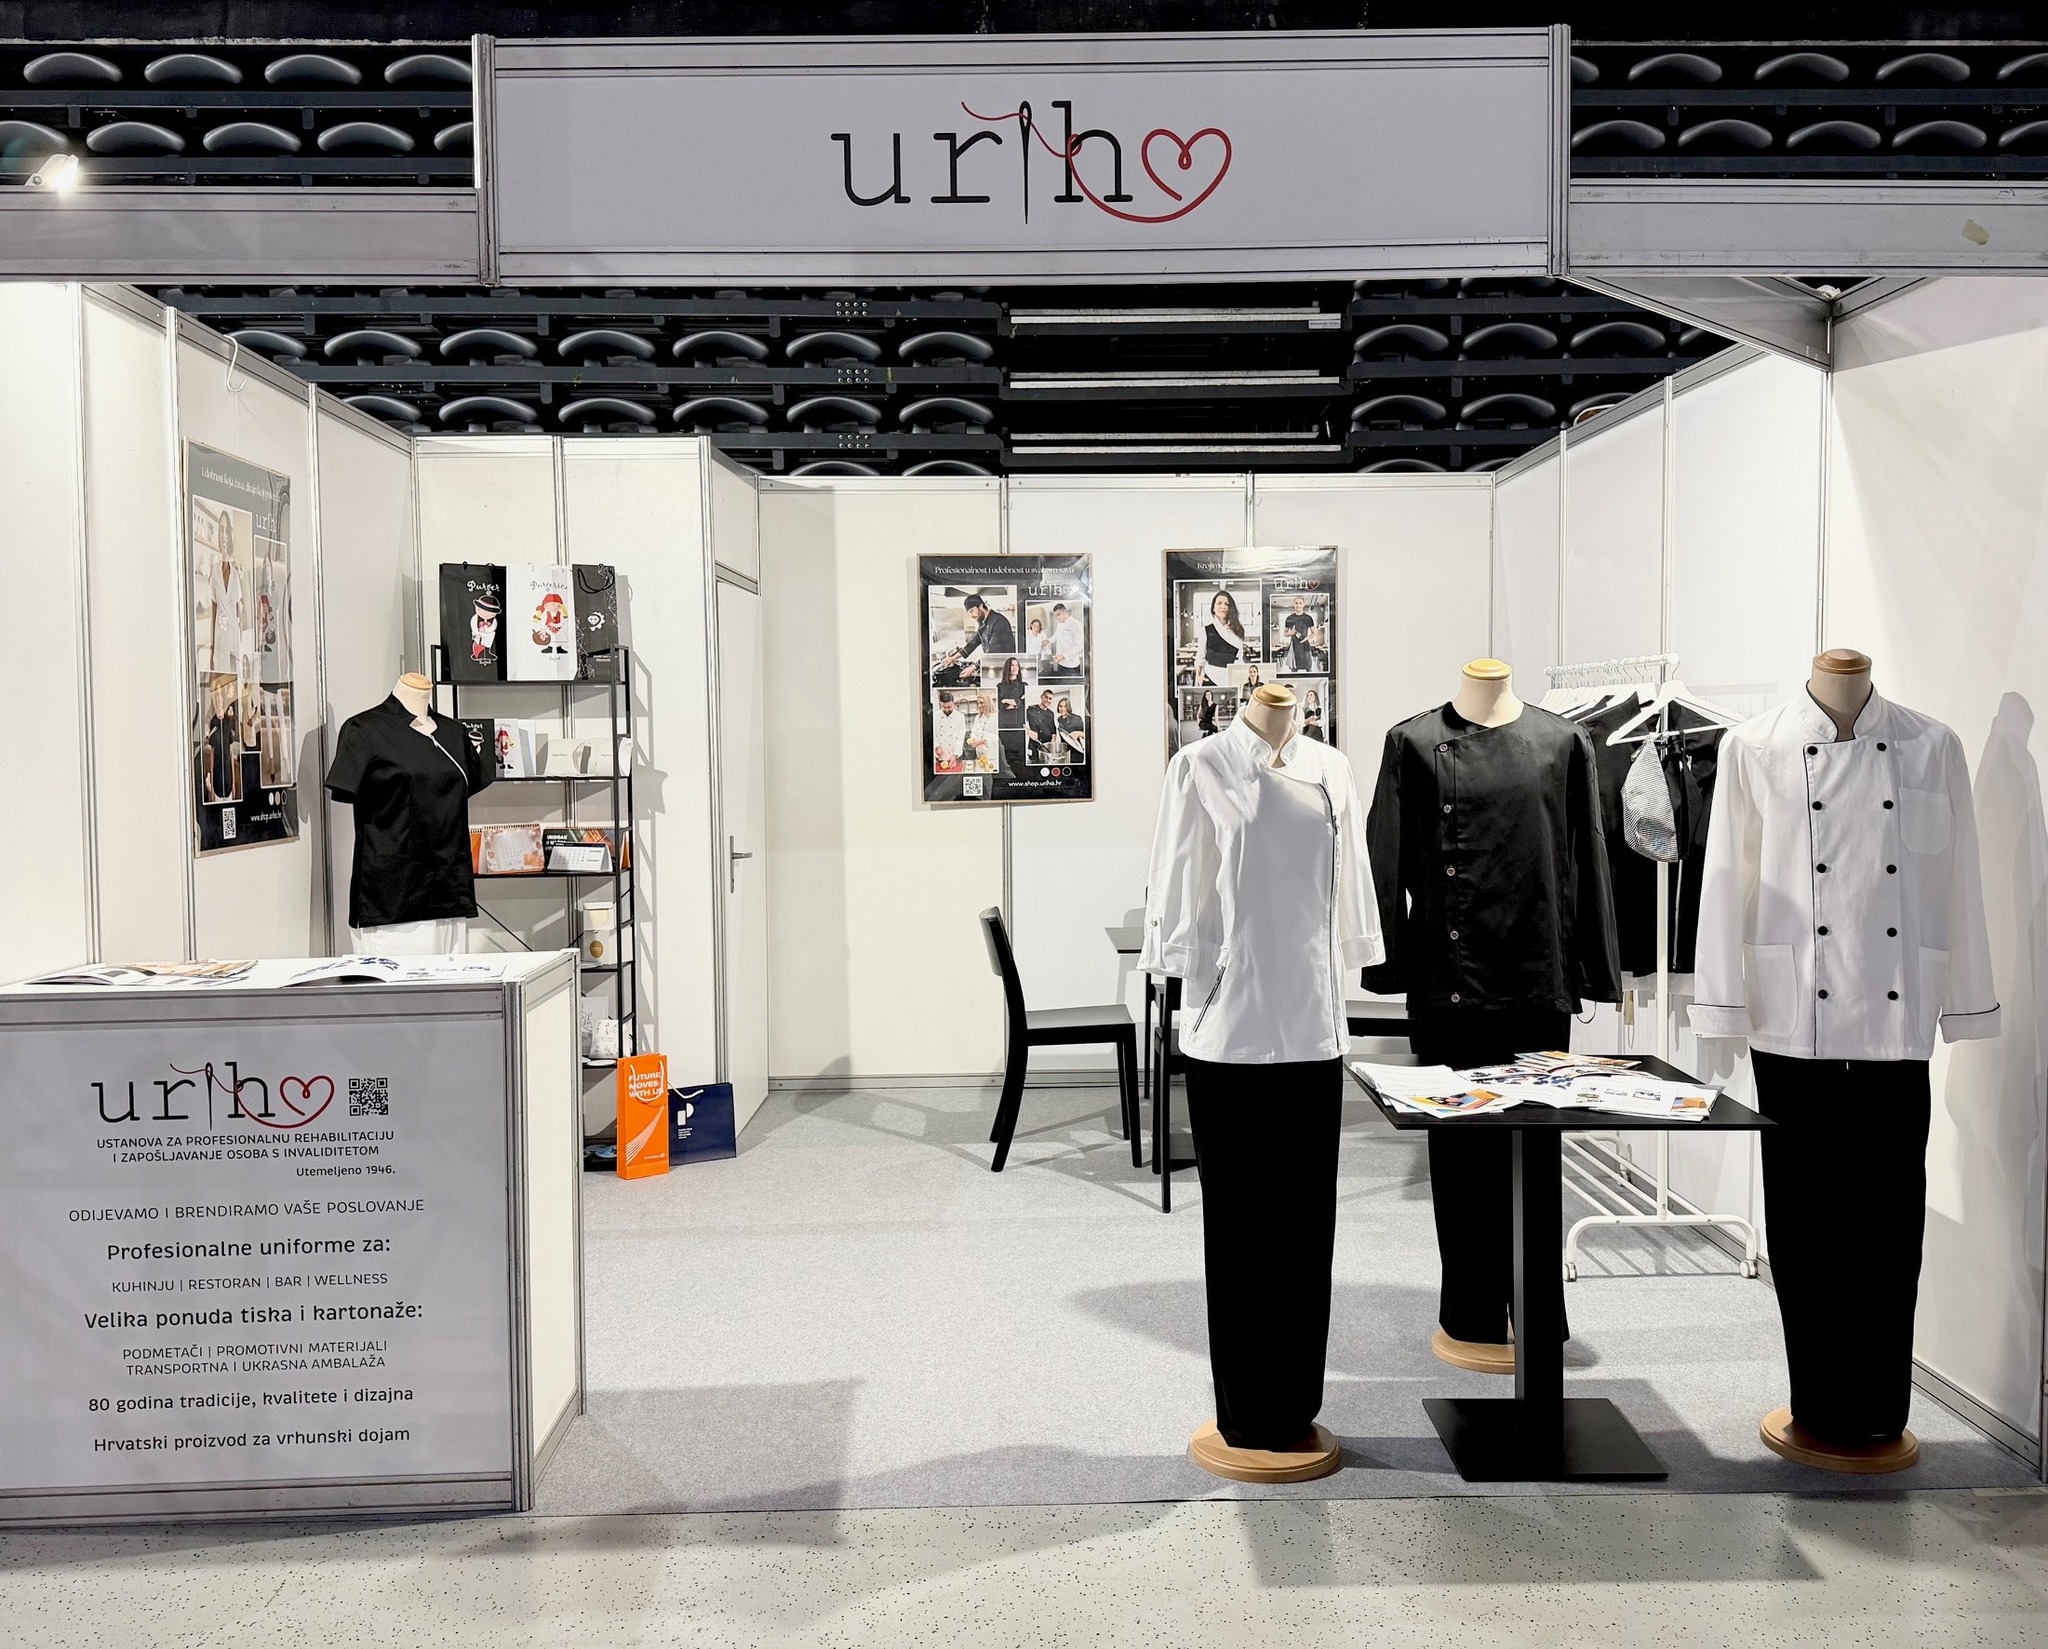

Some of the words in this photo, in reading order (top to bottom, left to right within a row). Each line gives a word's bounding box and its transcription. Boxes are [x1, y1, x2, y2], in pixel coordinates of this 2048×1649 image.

[934, 566, 988, 574] Profesionalnost
[992, 566, 1024, 574] udobnost
[97, 1138, 163, 1148] USTANOVA
[167, 1137, 182, 1146] ZA
[186, 1132, 290, 1146] PROFESIONALNU
[295, 1131, 393, 1142] REHABILITACIJU
[121, 1149, 222, 1162] ZAPOŠLJAVANJE
[227, 1149, 268, 1159] OSOBA
[284, 1145, 379, 1157] INVALIDITETOM
[297, 1166, 362, 1177] Utemeljeno
[366, 1165, 395, 1174] 1946.
[69, 1208, 158, 1221] ODIJEVAMO
[176, 1204, 278, 1218] BRENDIRAMO
[284, 1200, 320, 1214] VAŠE
[327, 1199, 424, 1213] POSLOVANJE
[108, 1241, 251, 1260] Profesionalne
[260, 1238, 355, 1255] uniforme
[363, 1239, 390, 1252] za:
[113, 1280, 174, 1292] KUHINJU
[189, 1278, 260, 1290] RESTORAN
[275, 1276, 301, 1287] BAR
[314, 1274, 387, 1285] WELLNESS
[84, 1311, 147, 1328] Velika
[157, 1309, 232, 1329] ponuda
[240, 1307, 291, 1323] tiska
[314, 1301, 422, 1321] kartonaže:
[123, 1344, 202, 1359] PODMETAČI
[217, 1344, 302, 1356] PROMOTIVNI
[309, 1341, 386, 1354] MATERIJALI
[126, 1361, 228, 1375] TRANSPORTNA
[243, 1360, 307, 1371] UKRASNA
[312, 1354, 385, 1369] AMBALAŽA
[89, 1398, 109, 1411] 80
[117, 1396, 173, 1413] godina
[180, 1393, 256, 1408] tradicije,
[263, 1391, 337, 1405] kvalitete
[354, 1387, 413, 1403] dizajna
[95, 1436, 167, 1451] Hrvatski
[175, 1433, 246, 1451] proizvod
[253, 1435, 270, 1445] za
[277, 1429, 351, 1444] vrhunski
[359, 1428, 409, 1444] dojam
